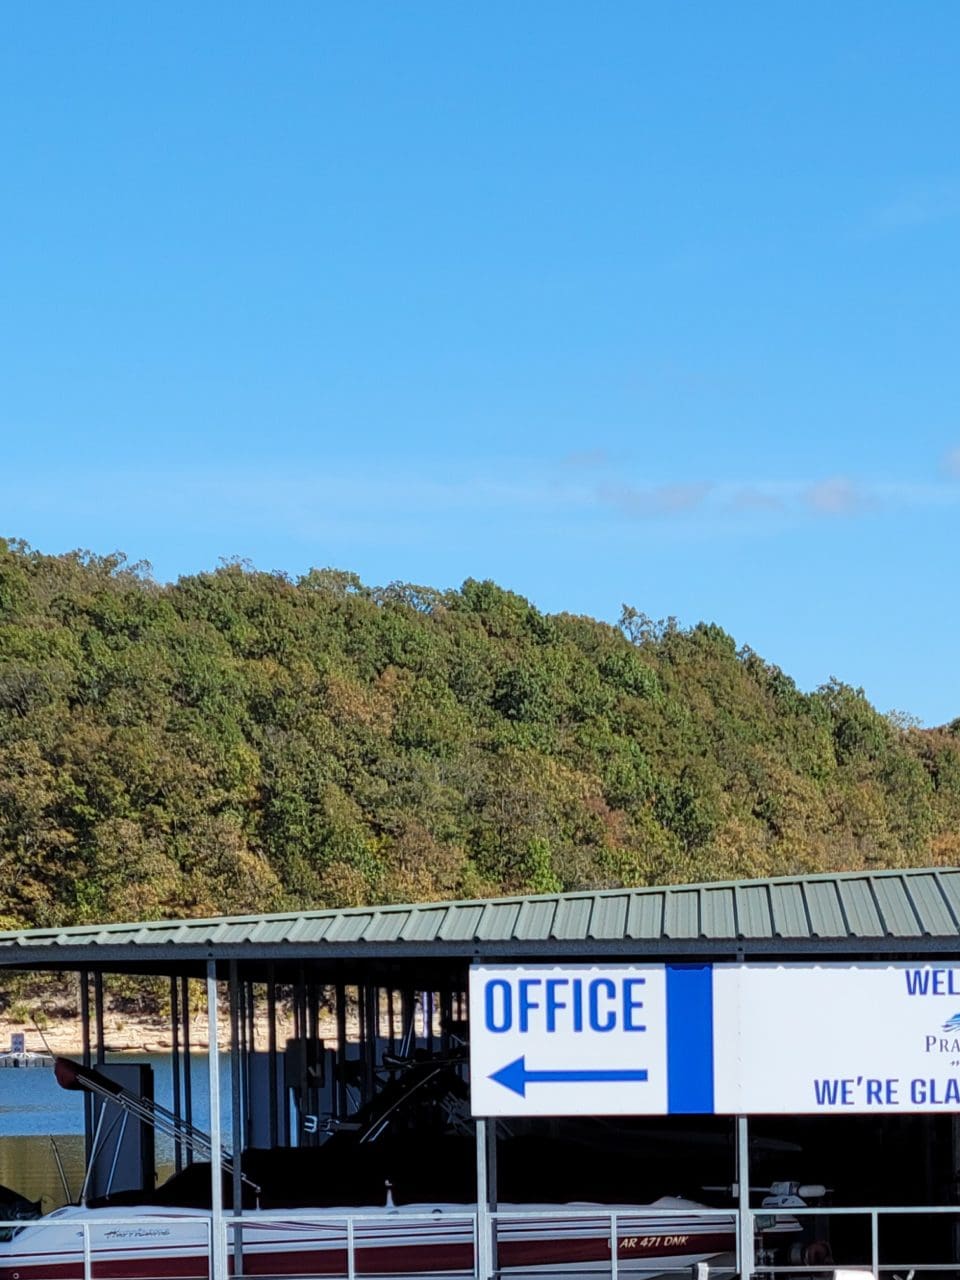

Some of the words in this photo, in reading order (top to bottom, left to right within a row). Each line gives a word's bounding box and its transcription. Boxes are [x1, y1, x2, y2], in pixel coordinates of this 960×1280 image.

[484, 977, 647, 1033] OFFICE
[813, 1076, 899, 1105] WE'RE
[619, 1237, 638, 1249] AR
[640, 1236, 661, 1248] 471
[663, 1235, 689, 1248] DNK
